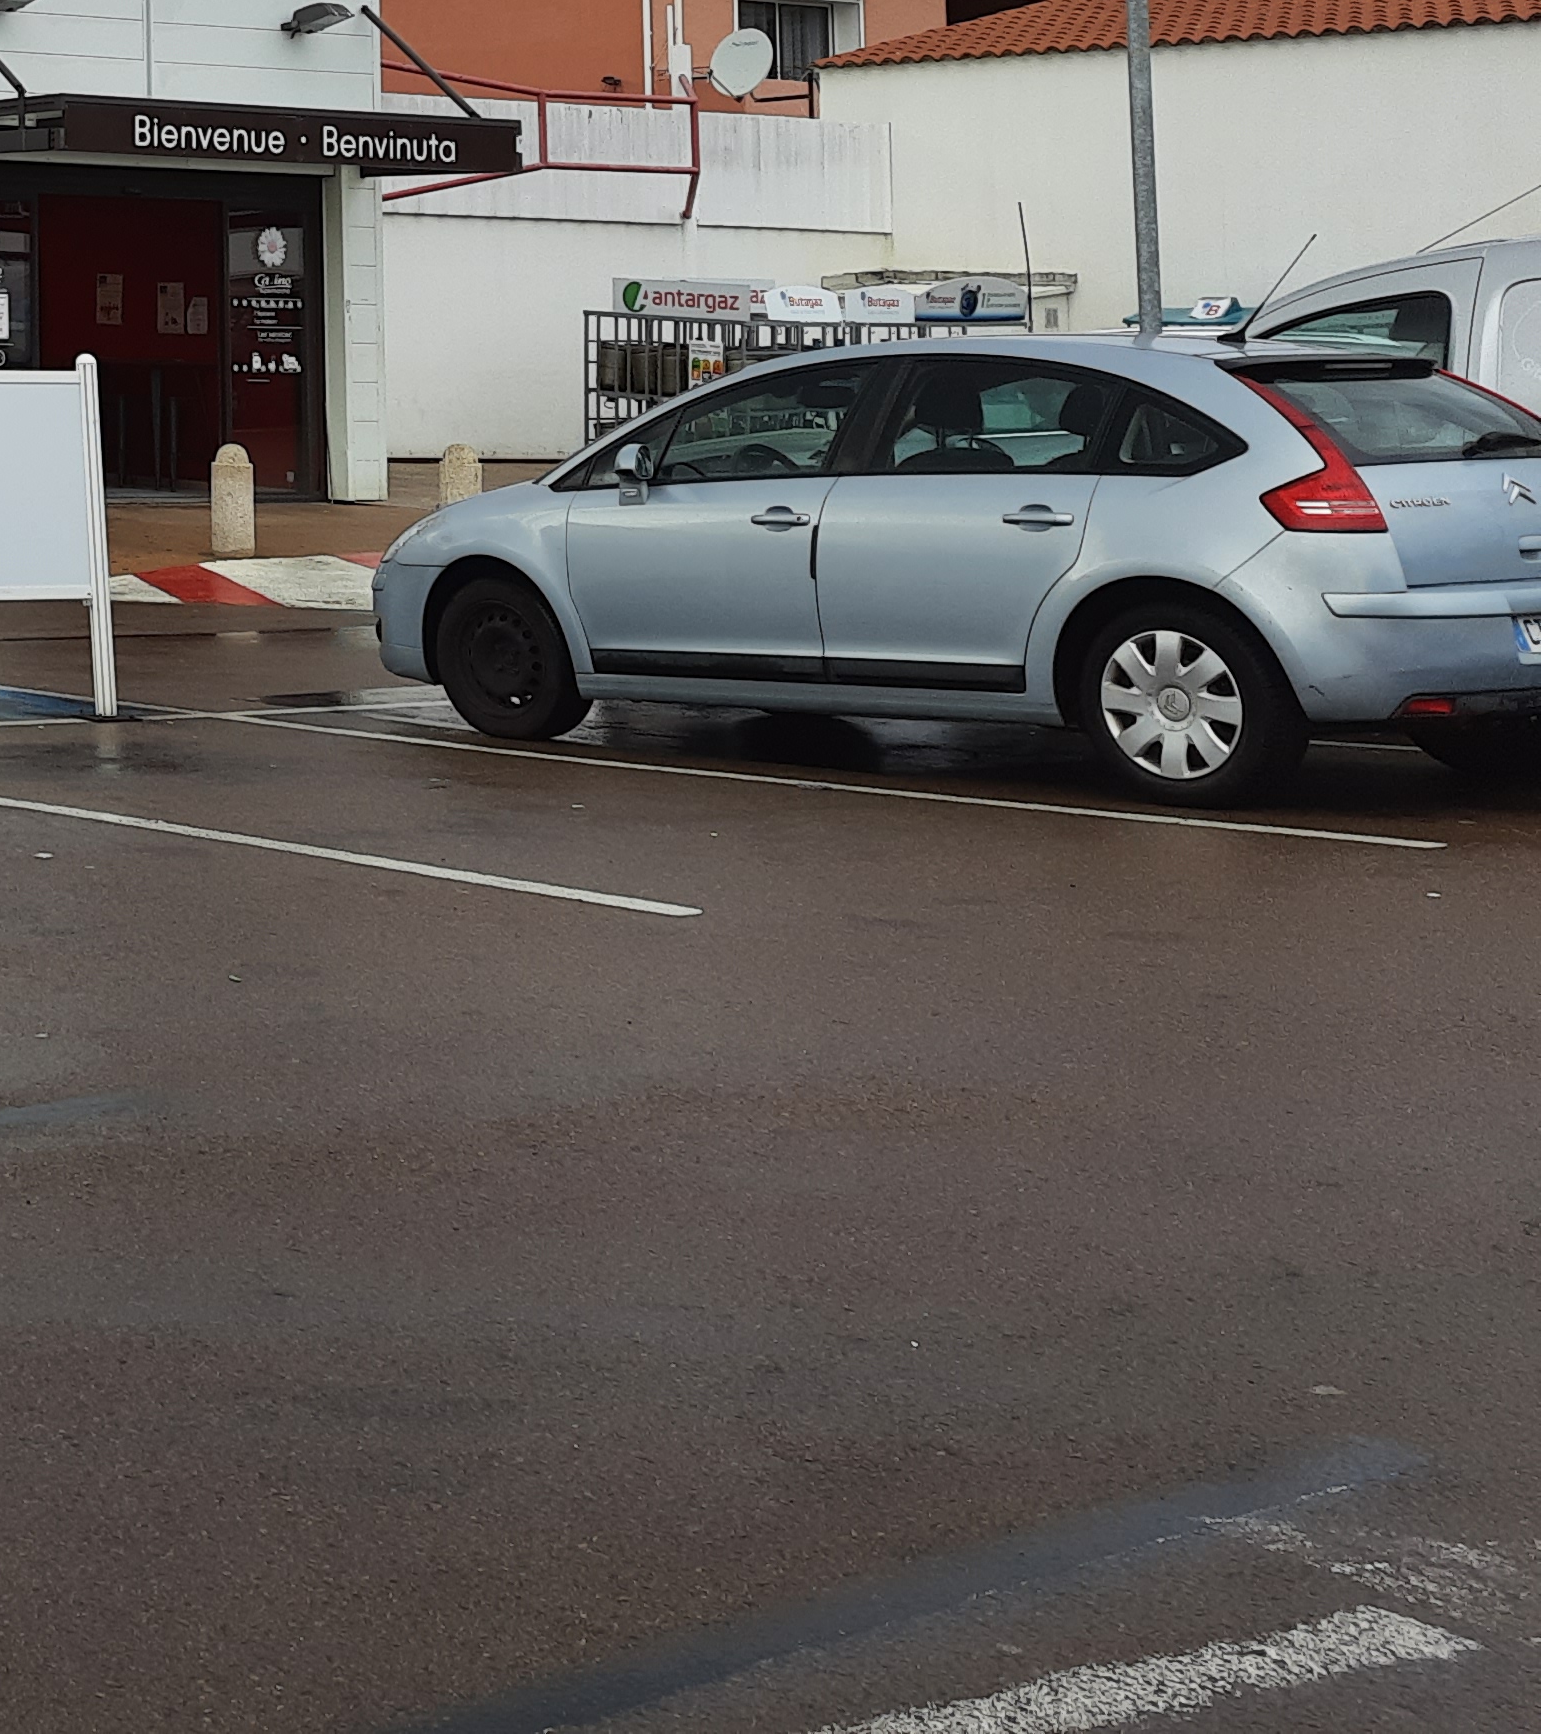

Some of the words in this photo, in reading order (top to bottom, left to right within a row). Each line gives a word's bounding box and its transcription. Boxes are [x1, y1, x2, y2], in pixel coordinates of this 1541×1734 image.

[134, 114, 286, 154] Bienvenue
[322, 125, 456, 163] Benvinuta
[651, 290, 740, 313] antargaz
